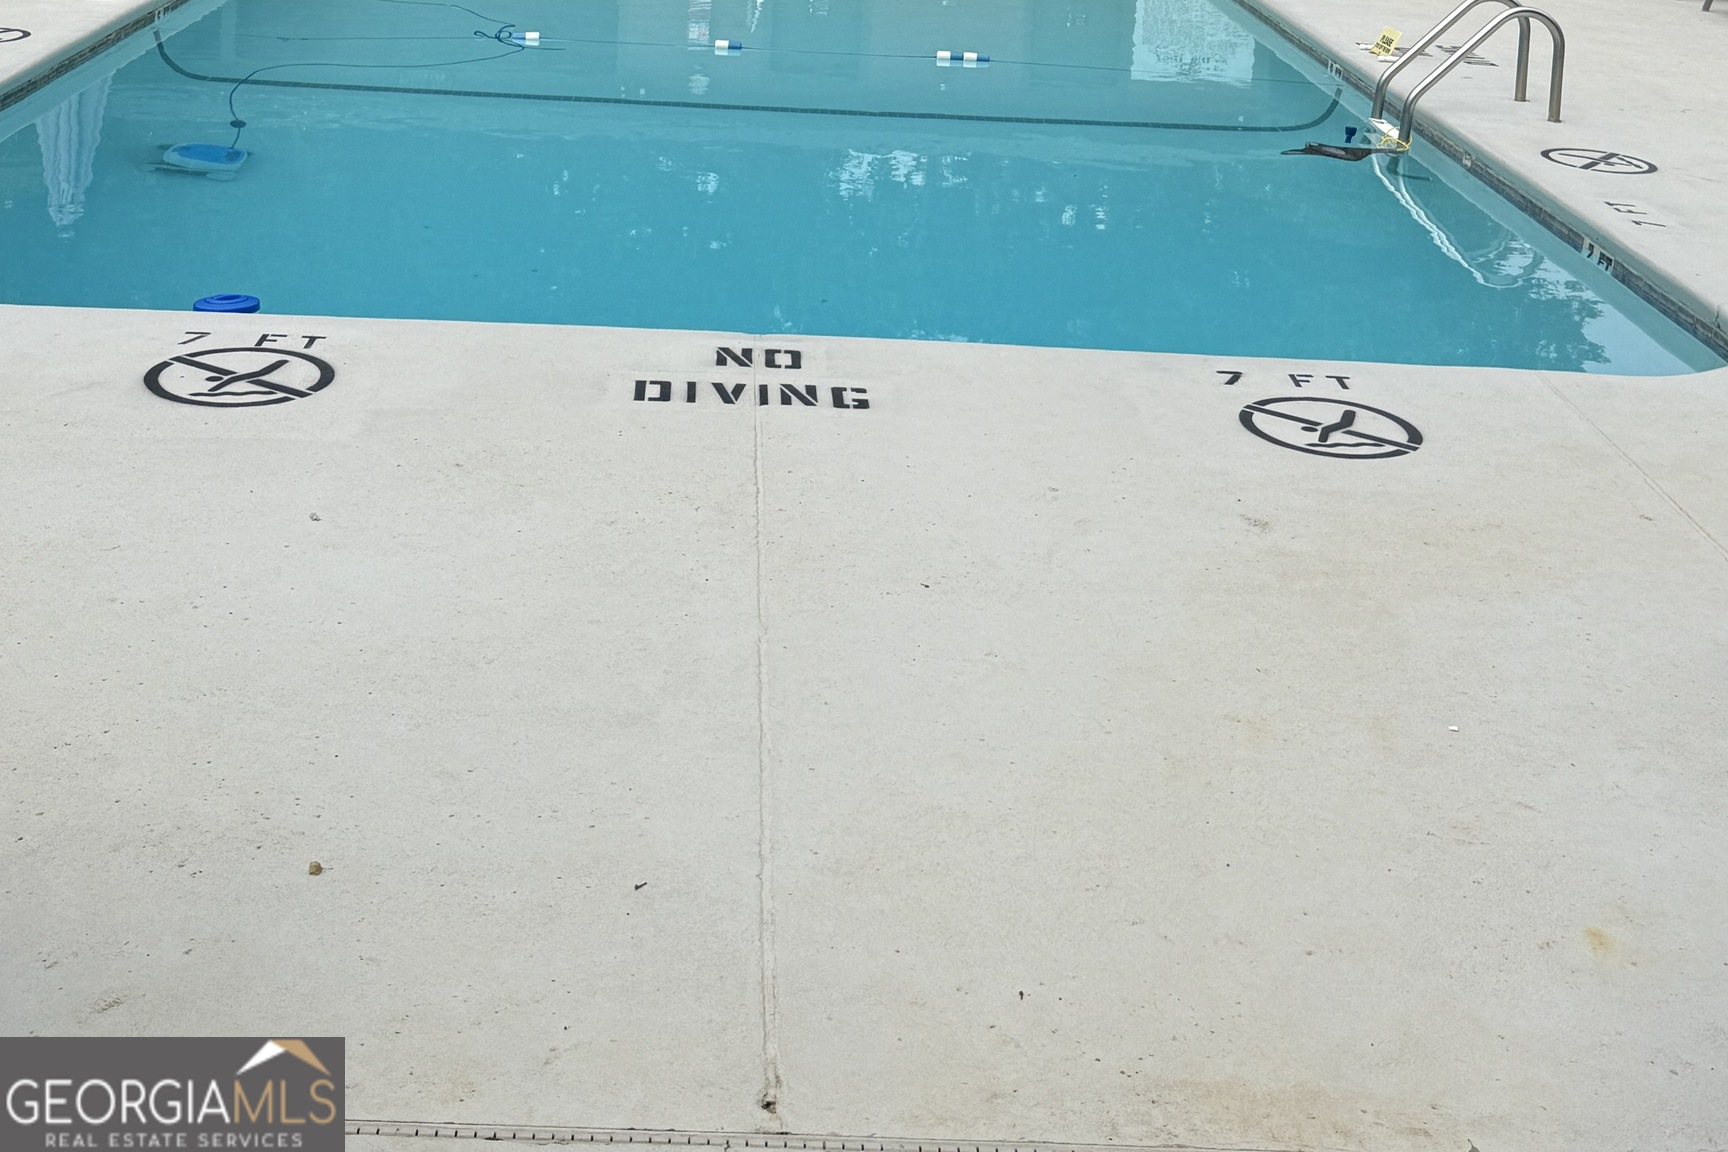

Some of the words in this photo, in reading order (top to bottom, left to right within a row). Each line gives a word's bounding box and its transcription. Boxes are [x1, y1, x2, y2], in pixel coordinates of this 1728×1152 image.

[1586, 241, 1595, 259] 7
[1597, 250, 1613, 272] FT
[177, 331, 212, 346] 7
[254, 333, 327, 349] FT
[716, 347, 802, 369] NO
[1216, 370, 1243, 386] 7
[1288, 374, 1350, 390] FT
[633, 380, 871, 410] DIVING
